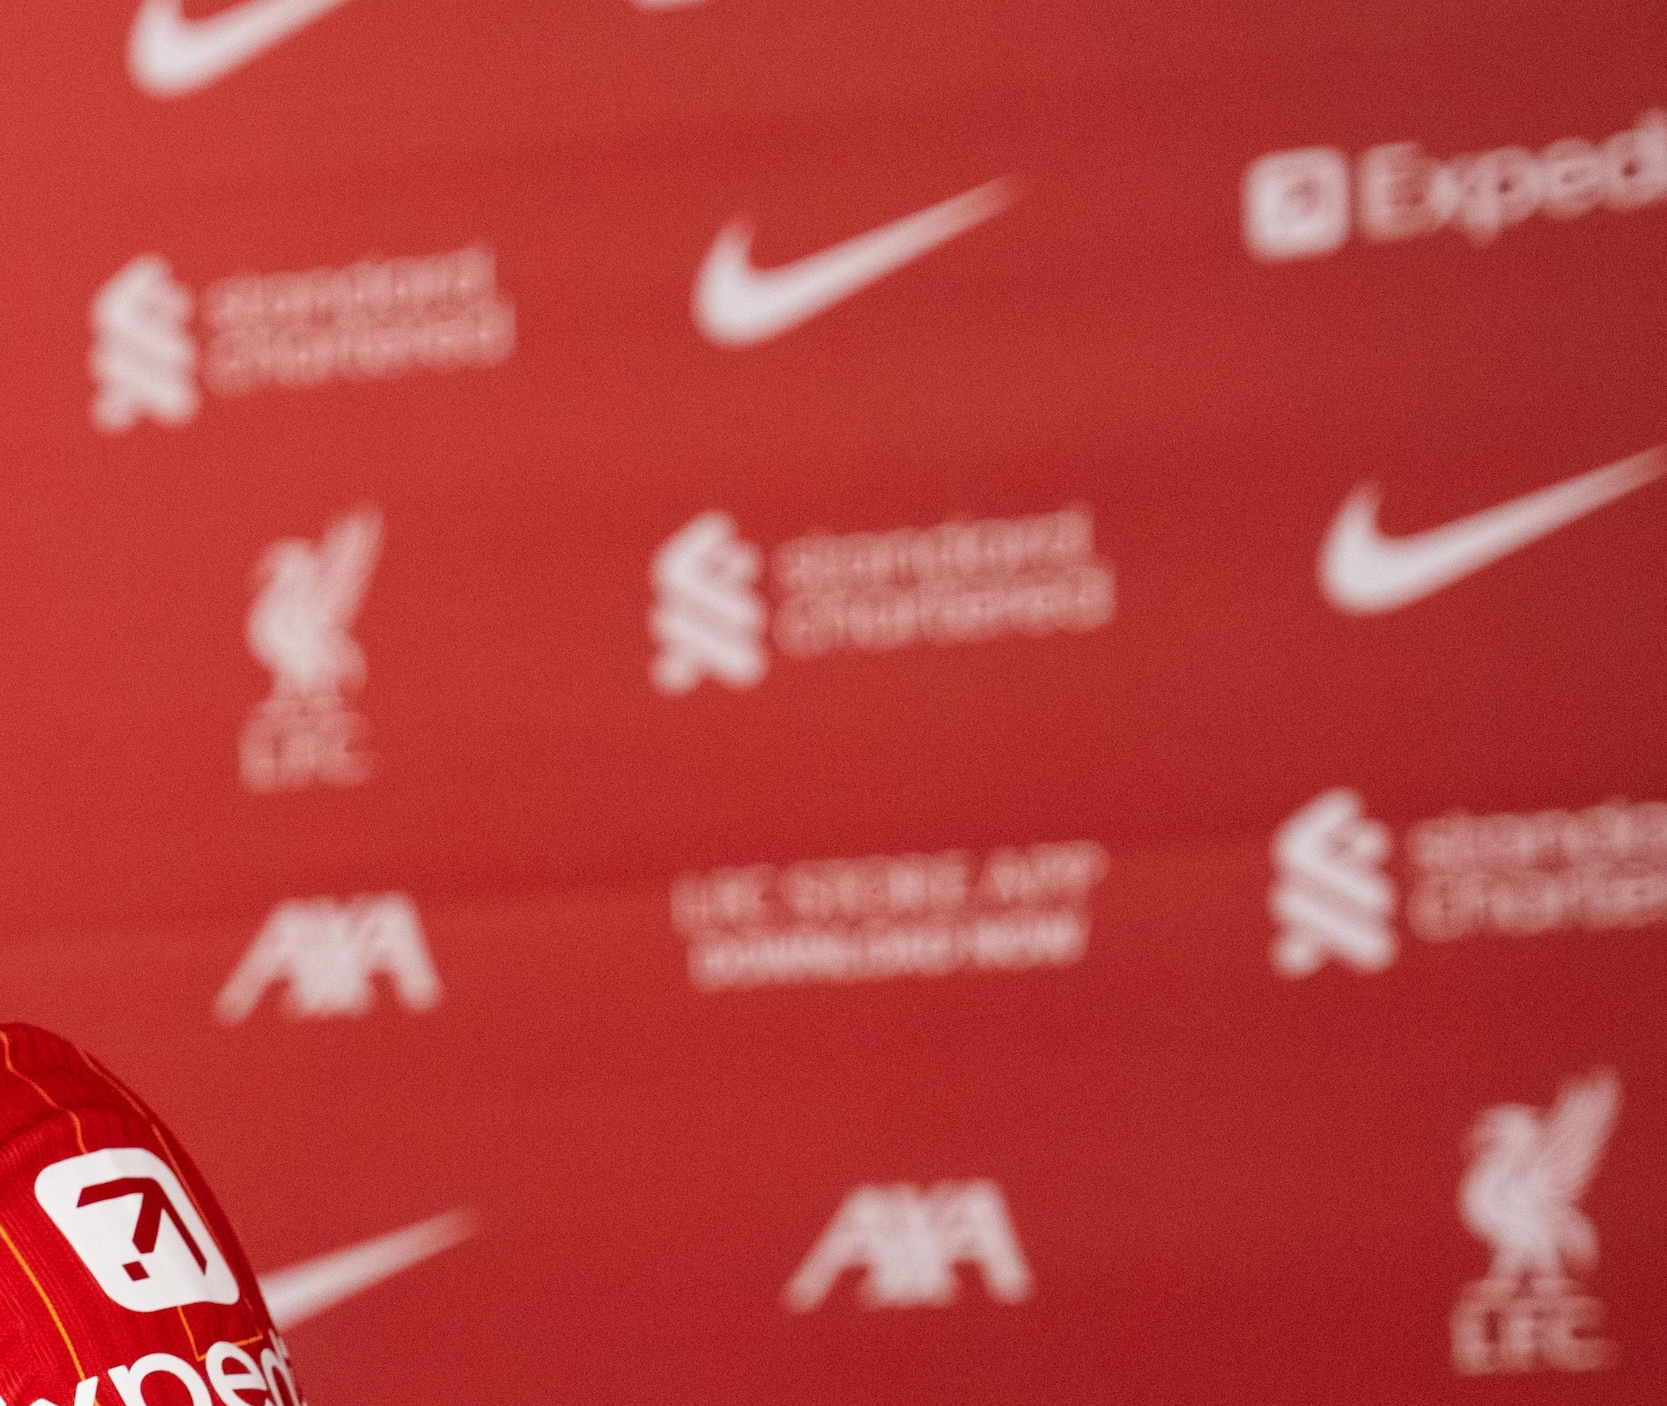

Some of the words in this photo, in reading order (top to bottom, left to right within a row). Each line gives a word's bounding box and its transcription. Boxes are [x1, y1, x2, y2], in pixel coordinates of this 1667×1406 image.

[771, 506, 1094, 586] standard
[774, 562, 1115, 658] chartered
[212, 892, 443, 1025] AXA
[779, 1177, 1036, 1314] AXA
